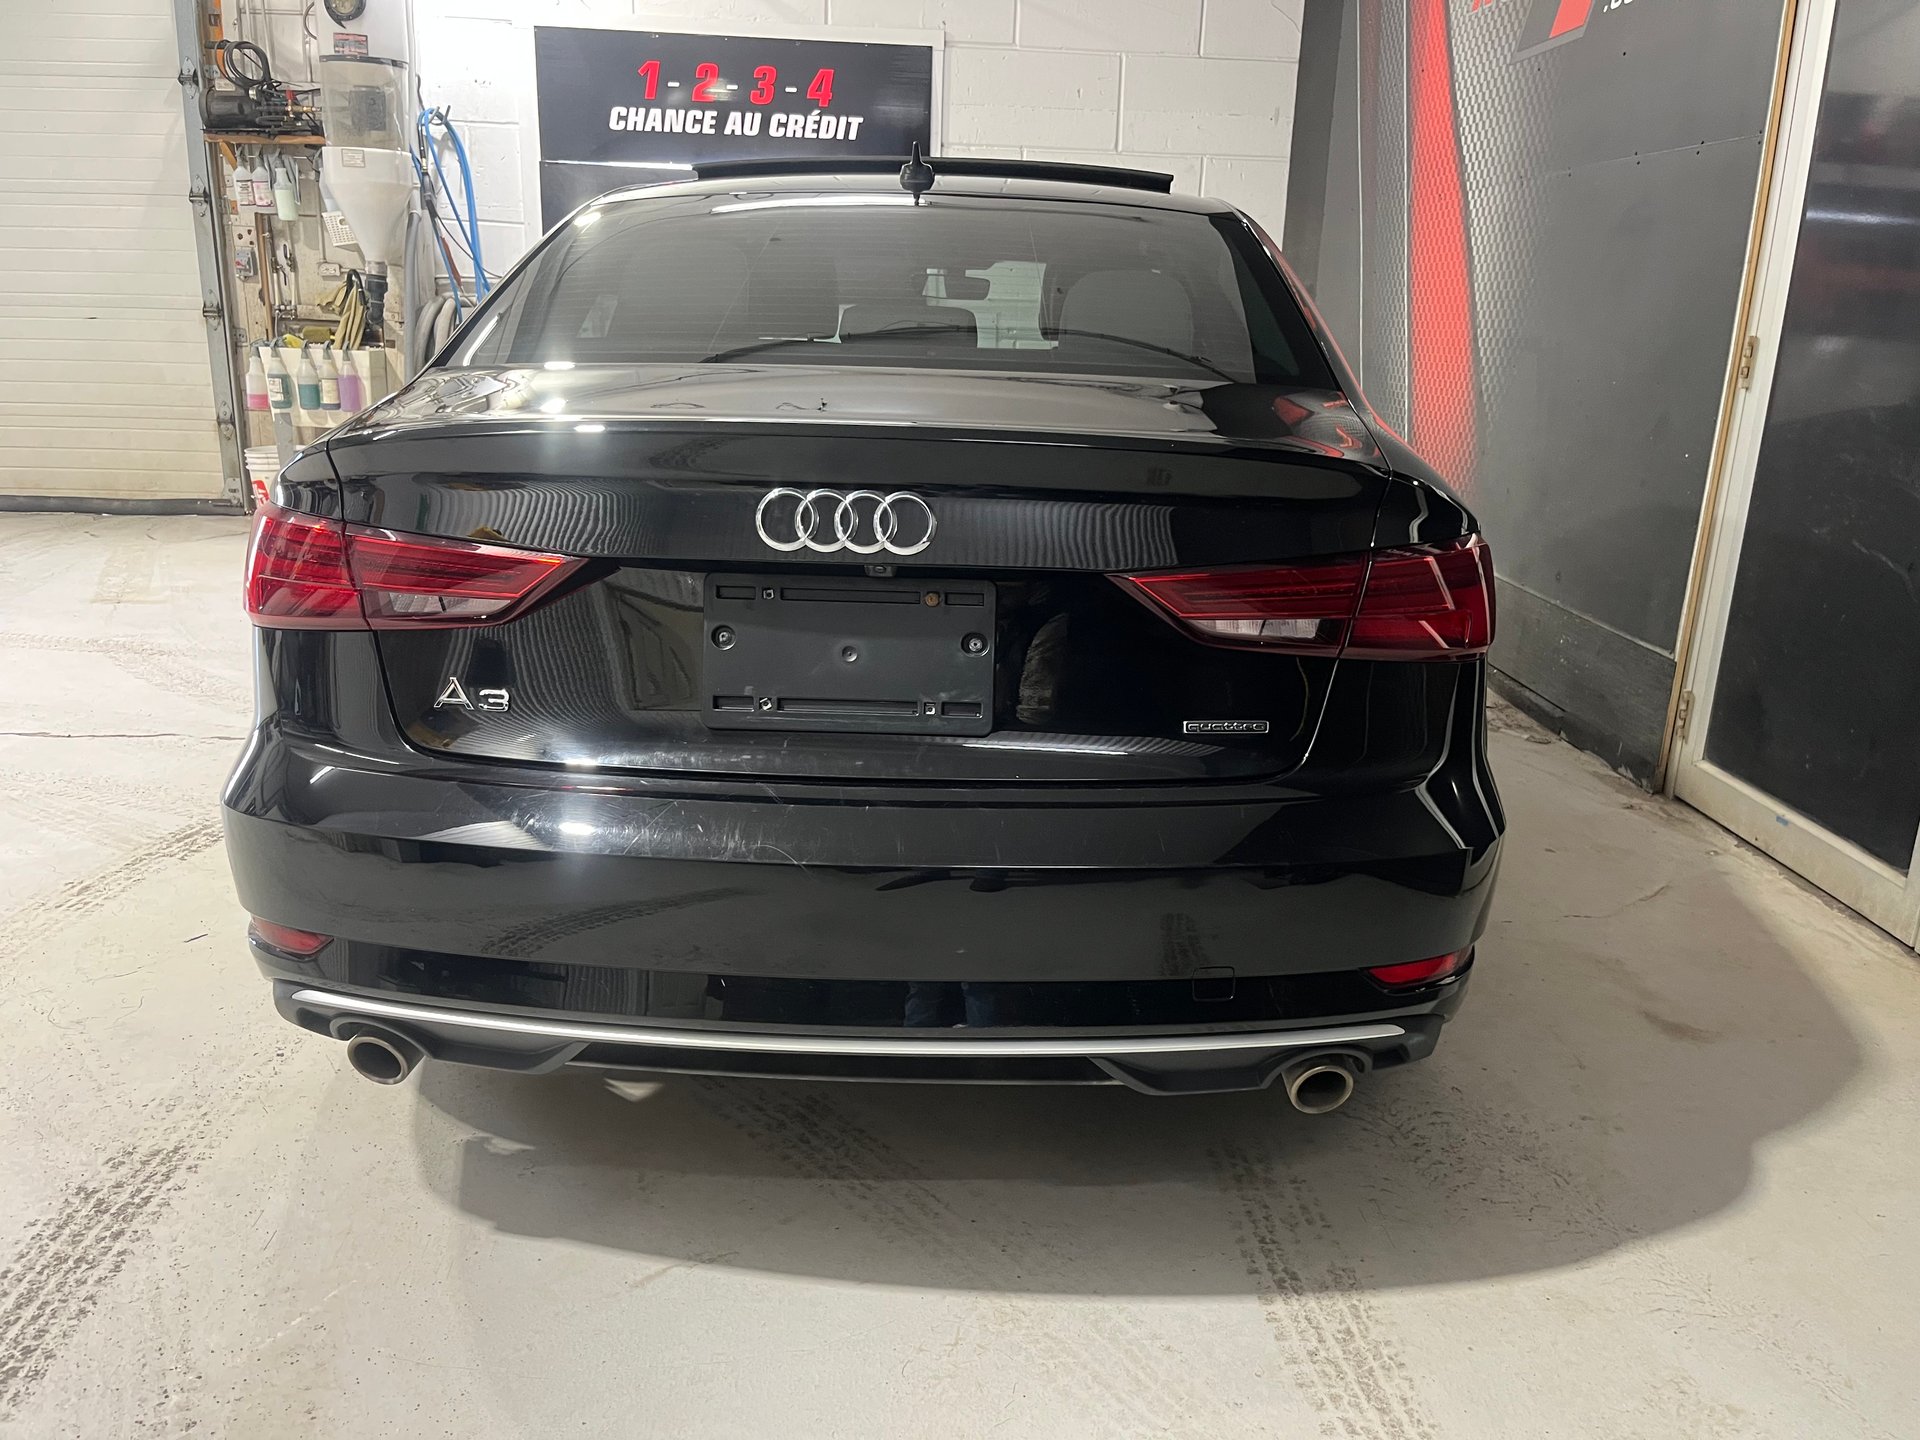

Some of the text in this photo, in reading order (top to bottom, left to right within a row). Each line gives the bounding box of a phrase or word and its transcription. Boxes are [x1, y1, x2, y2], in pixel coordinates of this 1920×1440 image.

[608, 106, 864, 141] CHANCE AU CRÉDIT
[433, 676, 510, 712] A3
